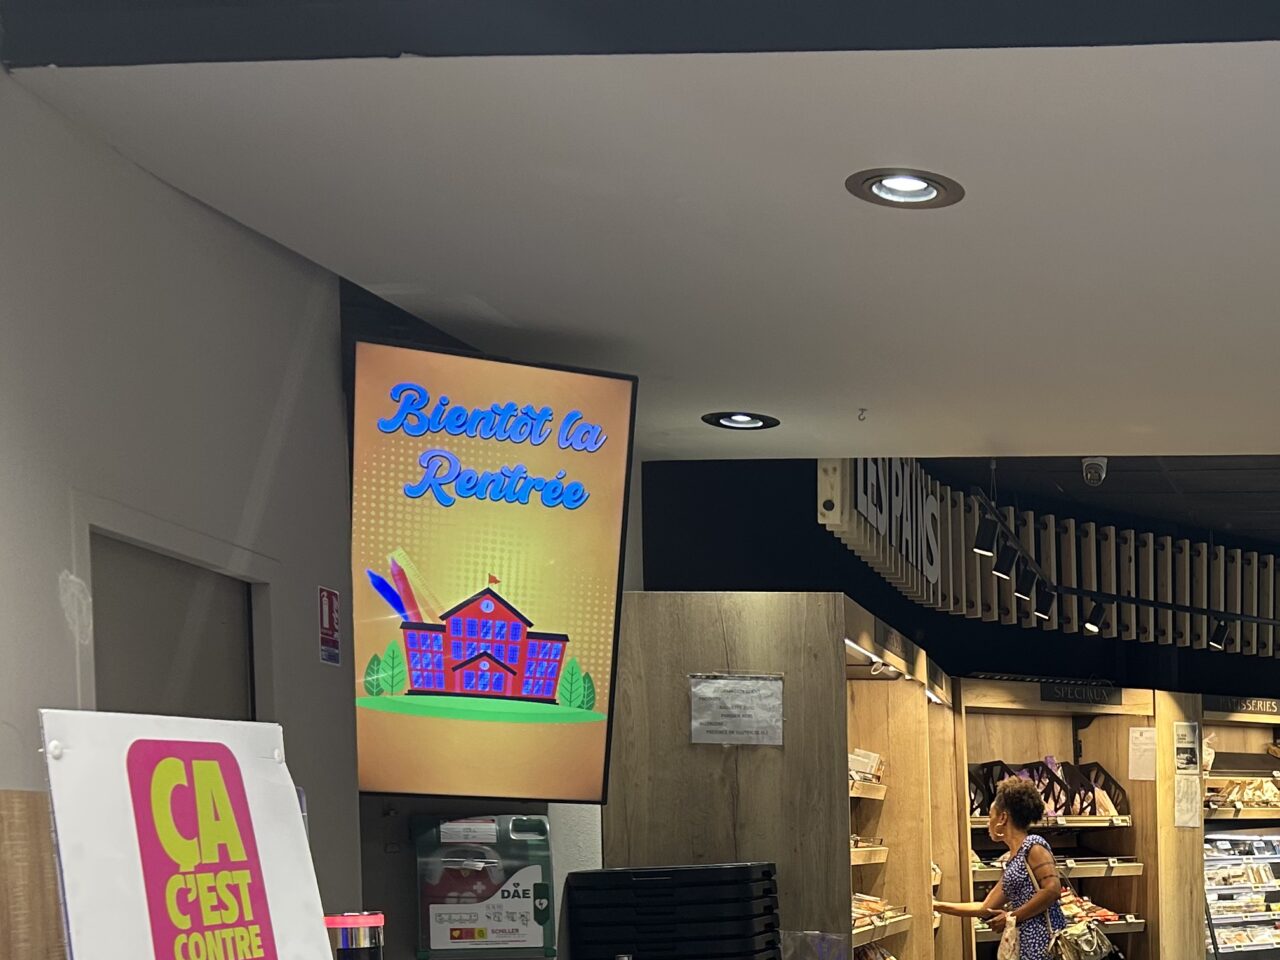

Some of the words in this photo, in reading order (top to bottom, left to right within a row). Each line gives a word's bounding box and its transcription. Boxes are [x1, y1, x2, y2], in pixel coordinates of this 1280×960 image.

[377, 382, 553, 446] Bientôt
[557, 410, 608, 452] la
[404, 448, 590, 510] Rentrée
[150, 756, 248, 872] ÇA
[165, 870, 254, 930] C'EST
[501, 889, 531, 899] DAE
